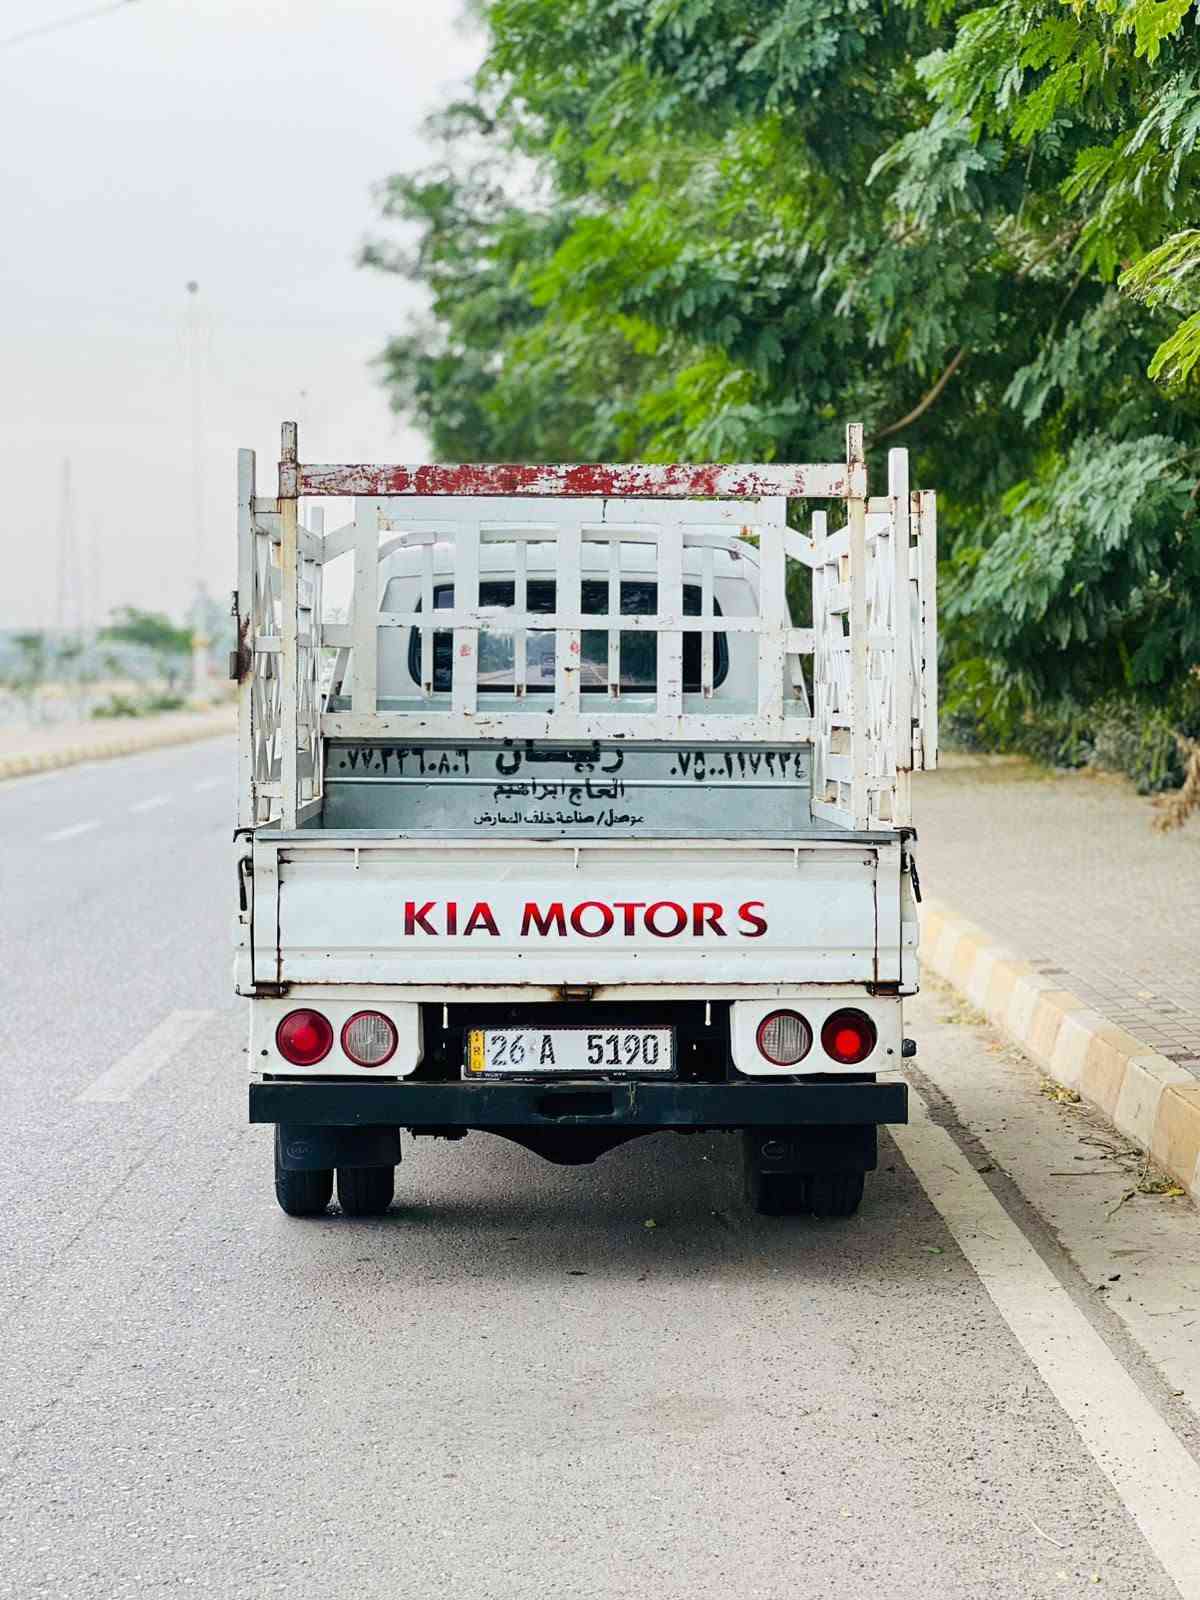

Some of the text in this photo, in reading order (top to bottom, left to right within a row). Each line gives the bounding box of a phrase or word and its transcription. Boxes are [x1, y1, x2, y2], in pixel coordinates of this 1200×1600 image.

[404, 900, 769, 938] KIA MOTORS
[490, 1034, 660, 1066] 26 A 5190
